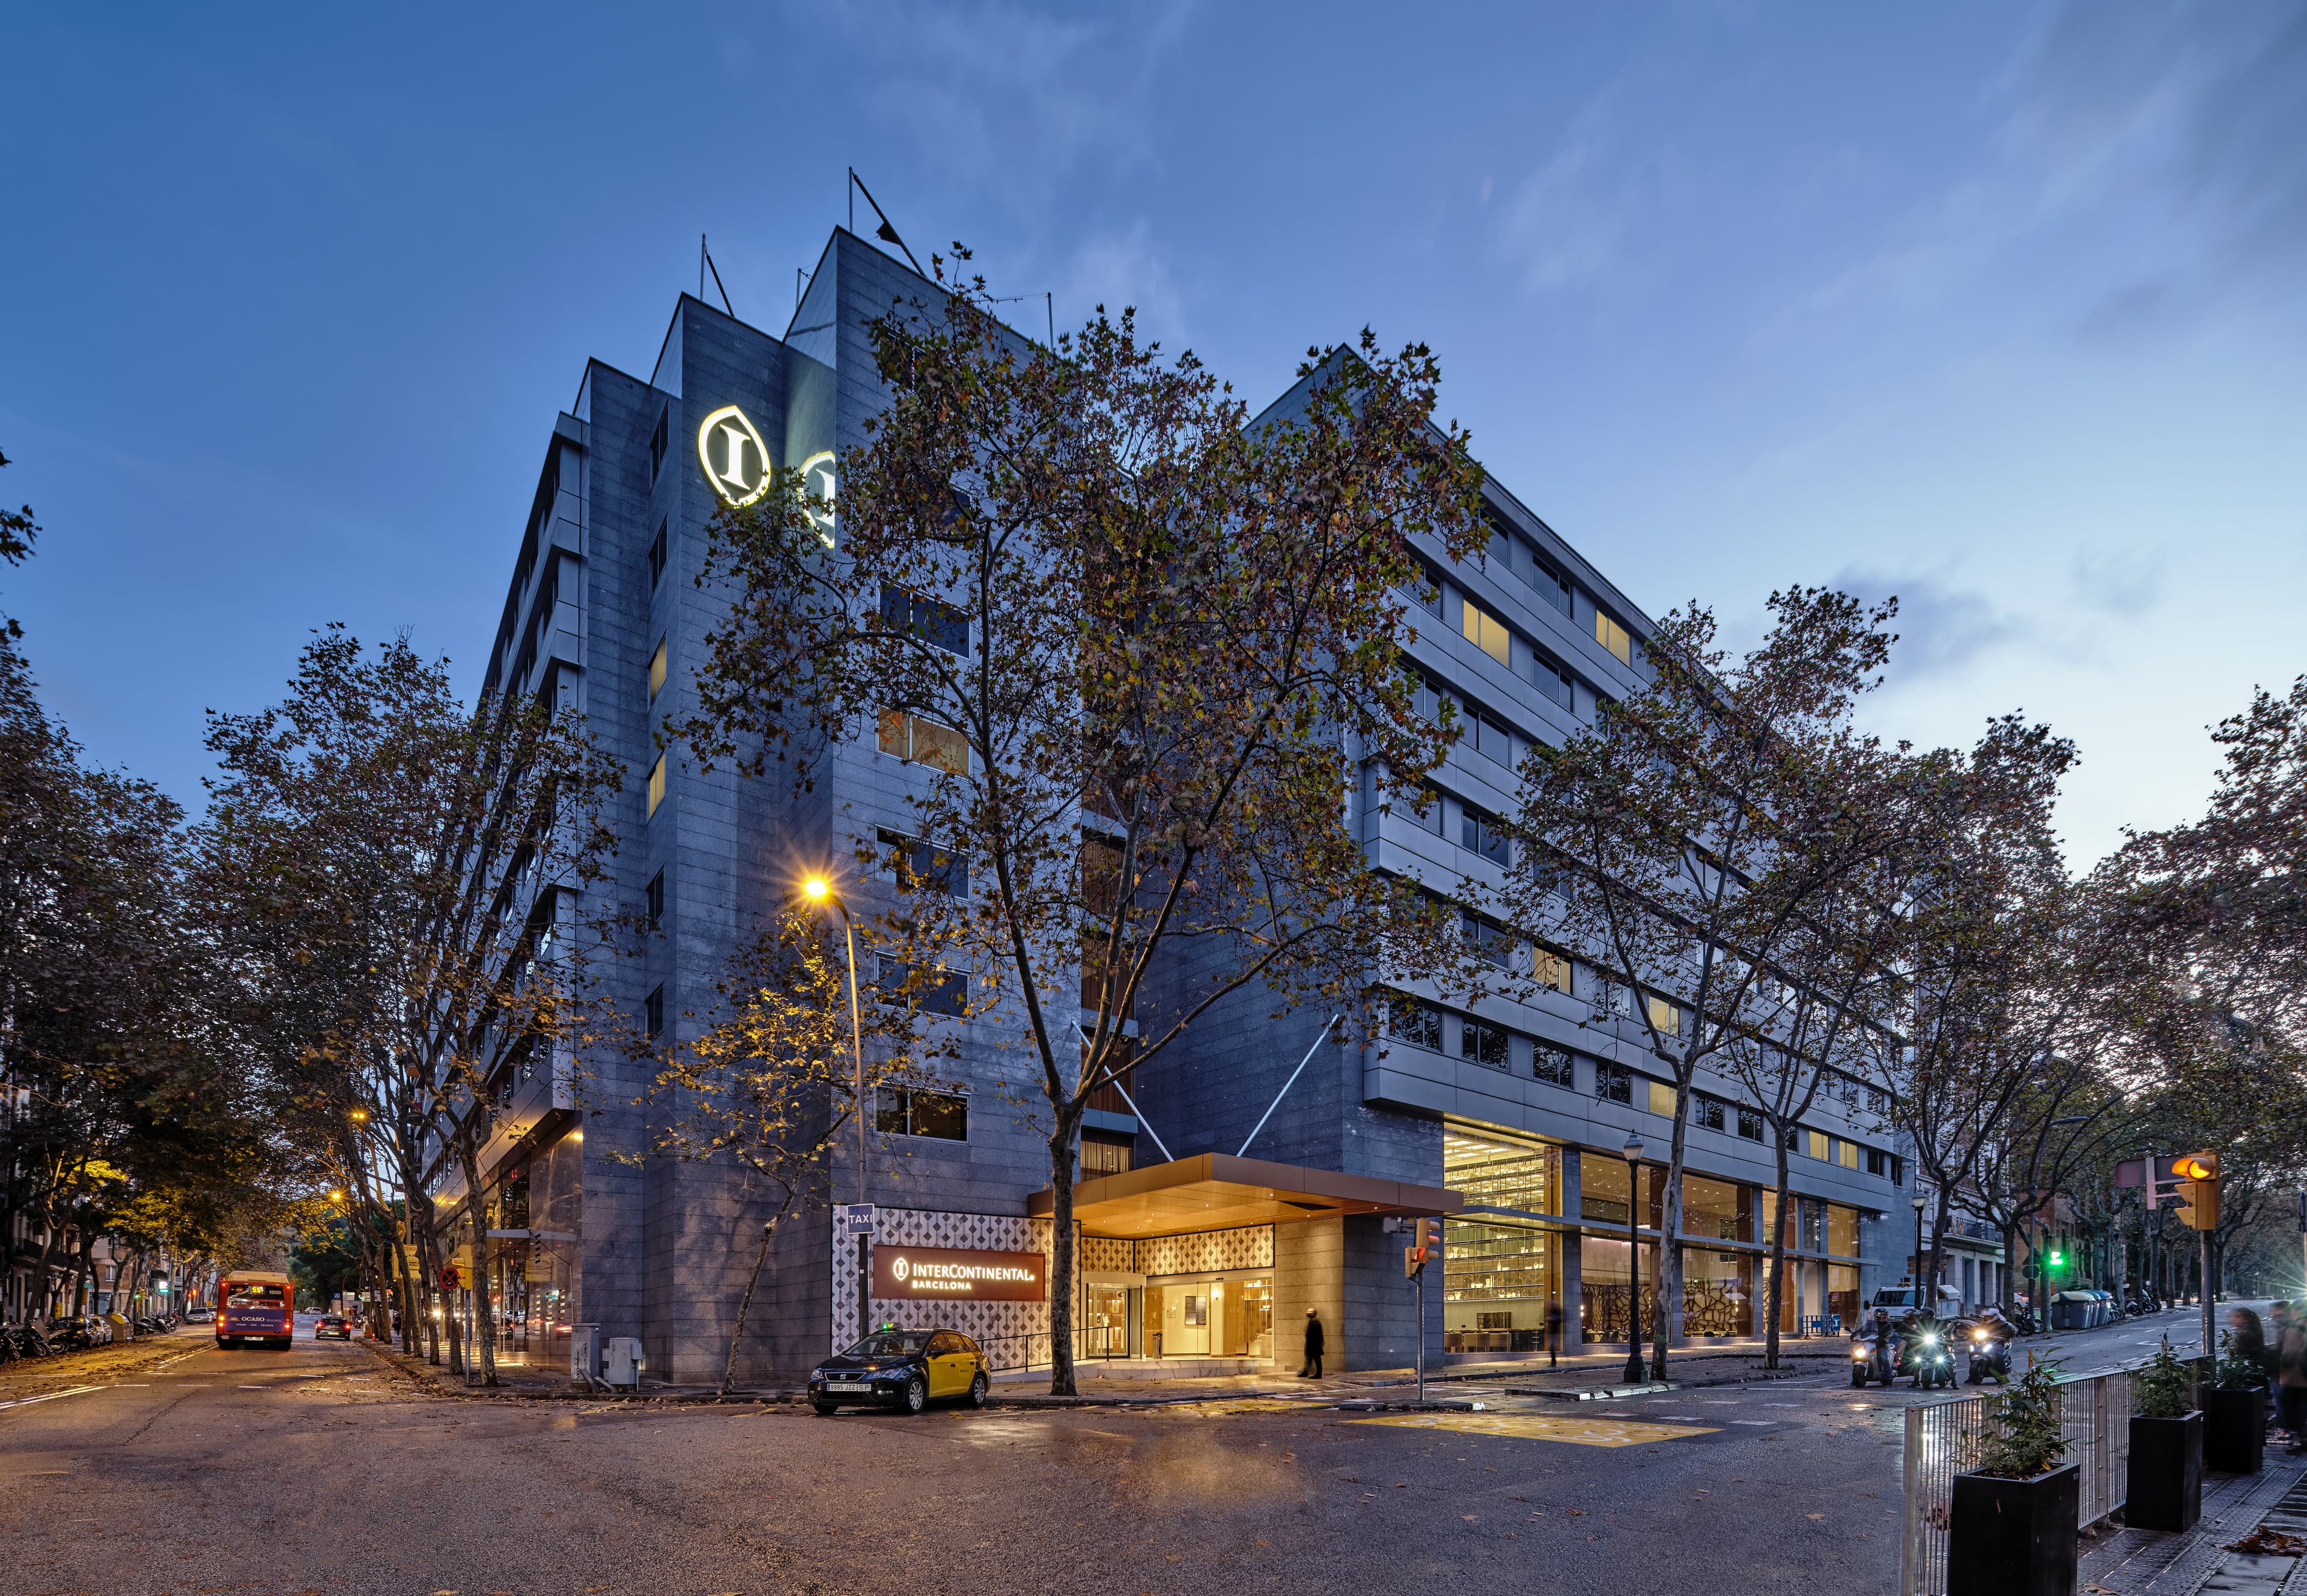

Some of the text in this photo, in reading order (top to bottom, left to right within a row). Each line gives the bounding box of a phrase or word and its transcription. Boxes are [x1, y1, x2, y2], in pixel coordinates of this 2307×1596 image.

[848, 1214, 872, 1224] TAXI
[913, 1263, 1031, 1281] INTERCONTINENTAL
[913, 1280, 971, 1290] BARCELONA
